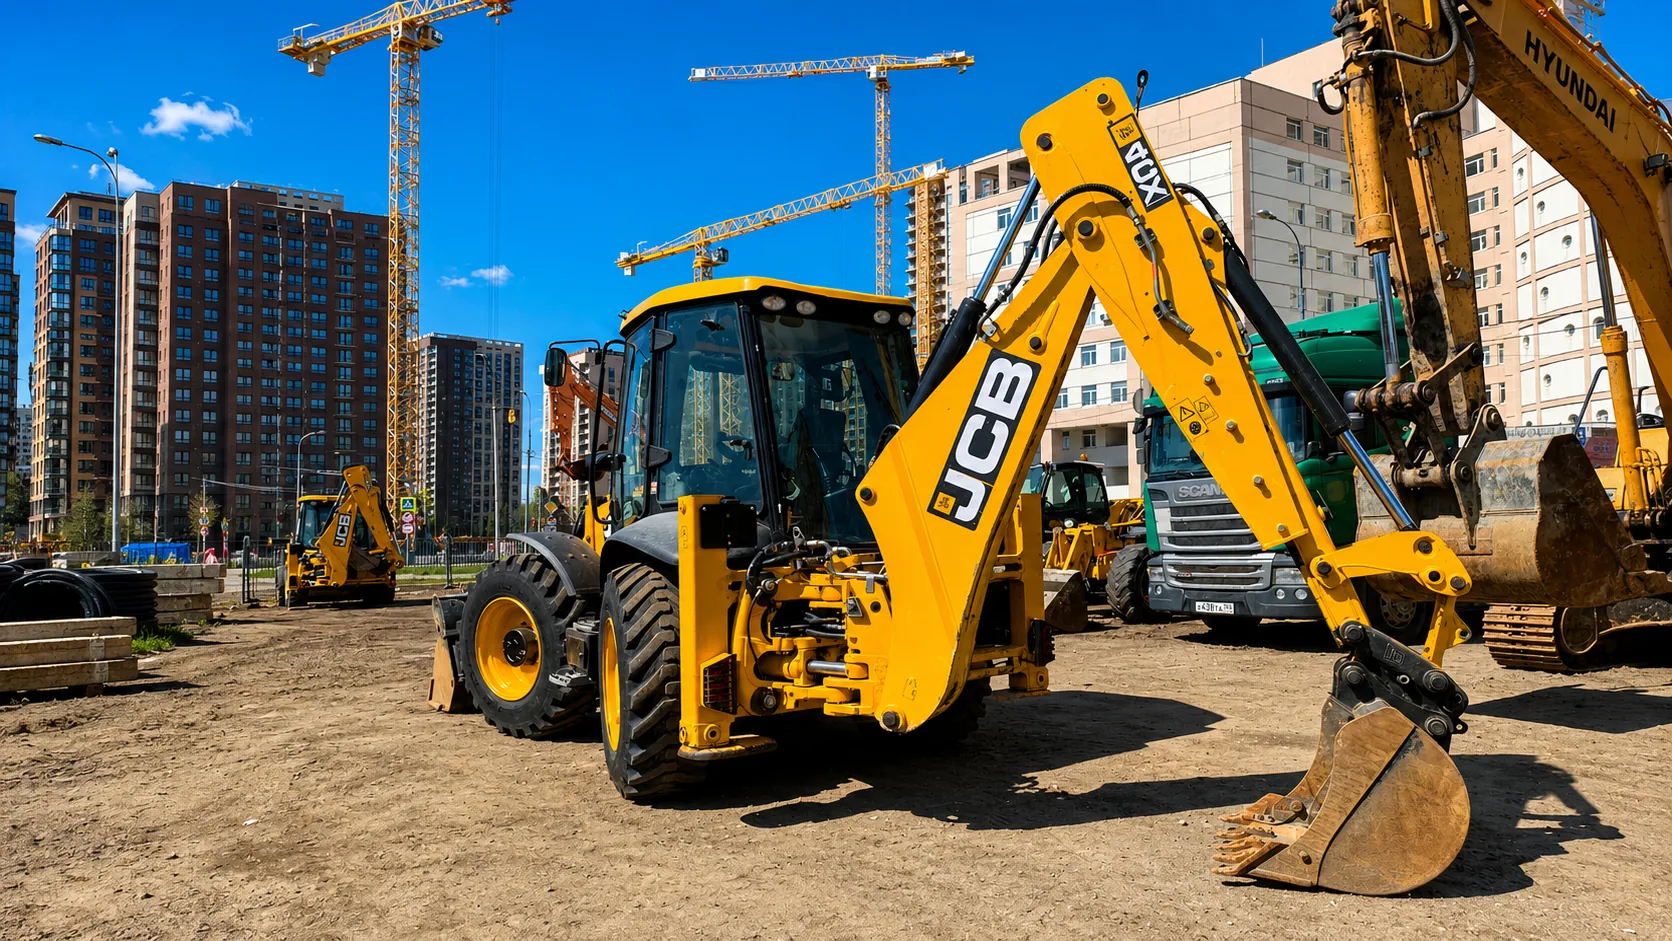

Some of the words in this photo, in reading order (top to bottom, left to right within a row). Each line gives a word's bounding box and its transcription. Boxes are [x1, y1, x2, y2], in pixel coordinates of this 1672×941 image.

[1525, 29, 1616, 133] HYUNDAI
[1124, 140, 1169, 205] 4CX
[944, 357, 1033, 522] JCB
[335, 514, 351, 547] JCB
